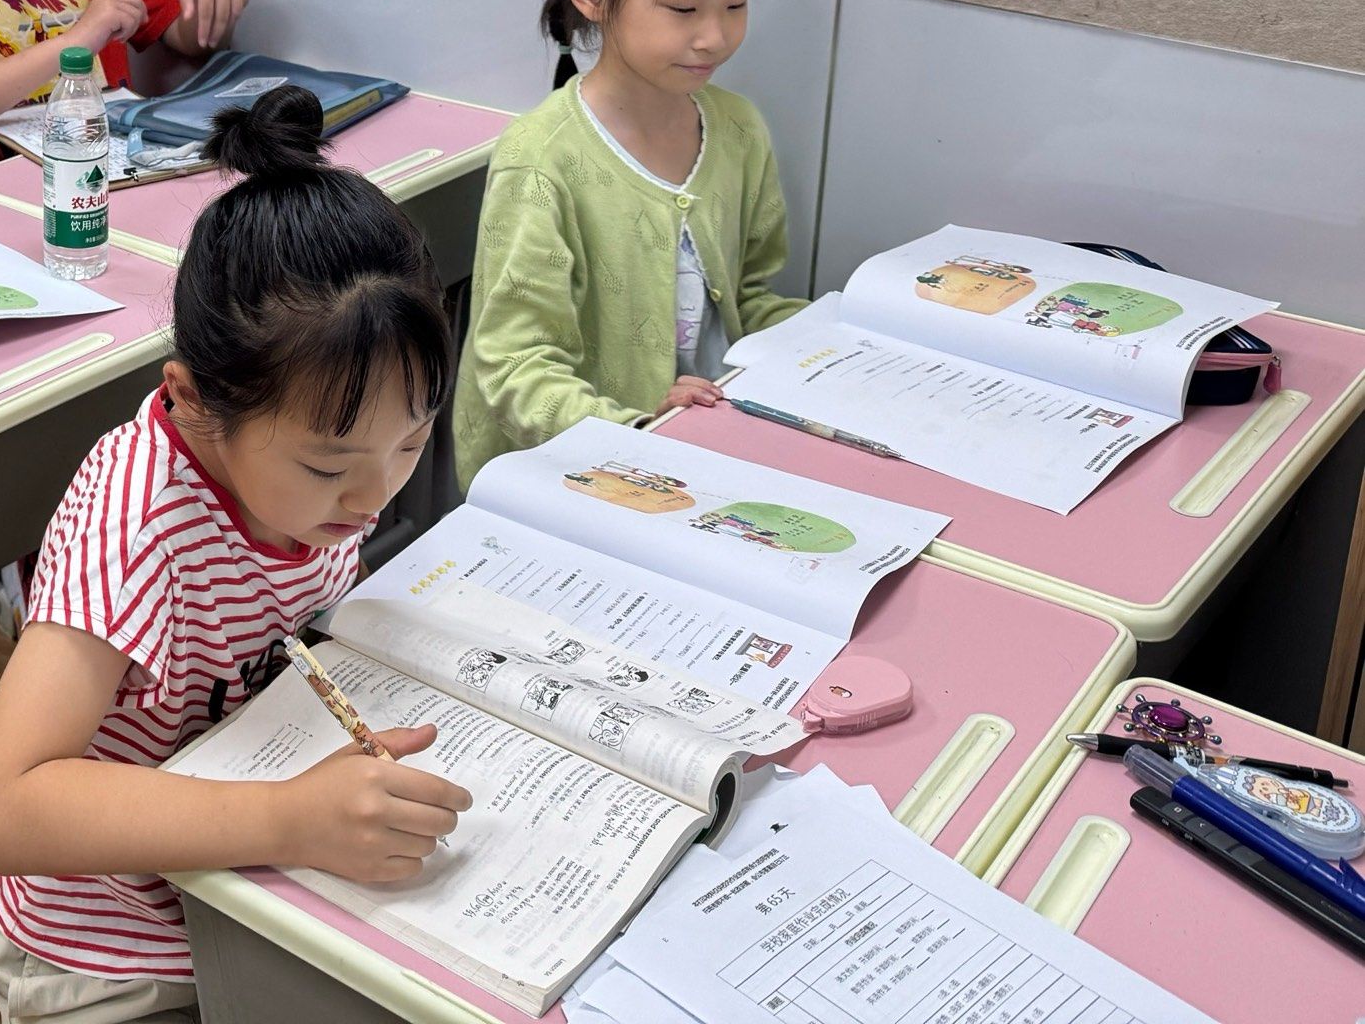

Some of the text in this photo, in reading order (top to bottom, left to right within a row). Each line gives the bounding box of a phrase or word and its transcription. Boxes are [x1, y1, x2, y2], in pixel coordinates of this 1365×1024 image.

[649, 818, 663, 829] and
[627, 827, 653, 859] expressions
[759, 887, 851, 954] 学校家庭作业完成情况
